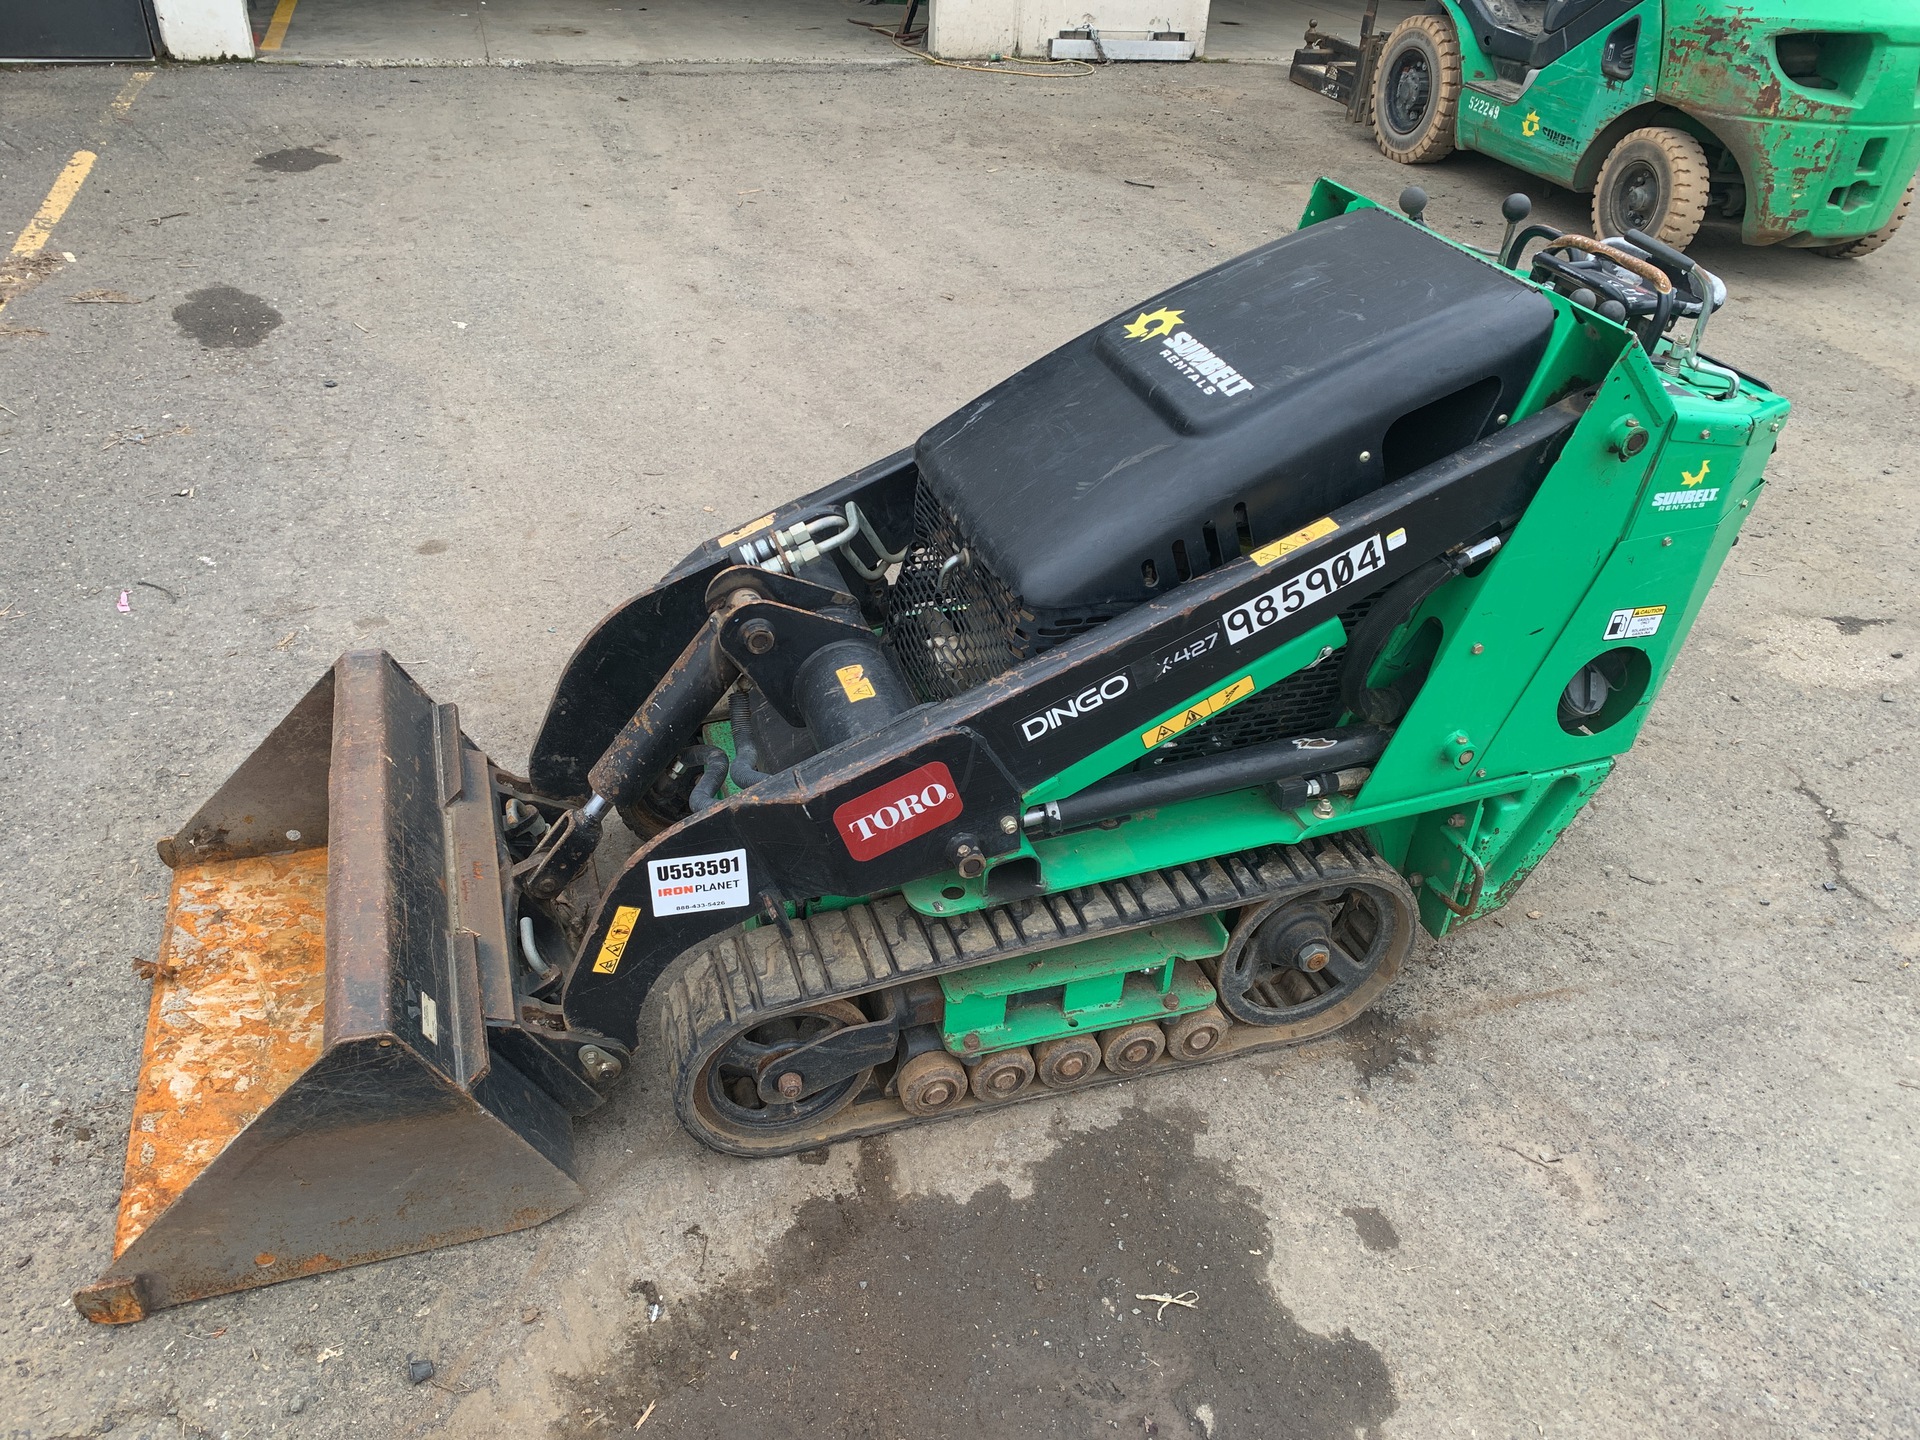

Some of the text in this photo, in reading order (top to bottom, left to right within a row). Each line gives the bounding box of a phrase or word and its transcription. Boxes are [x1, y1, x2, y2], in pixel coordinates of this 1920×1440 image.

[1468, 96, 1500, 120] 522249
[1159, 349, 1217, 395] RENTALS
[1162, 331, 1255, 397] SUNBELT
[1651, 487, 1720, 507] SUNBELT
[1658, 502, 1705, 511] RENTALS
[1227, 539, 1381, 635] 985904
[1021, 675, 1129, 742] DINGO
[848, 783, 947, 842] TORO
[656, 856, 740, 882] U553591
[676, 900, 726, 911] 888-433-5426
